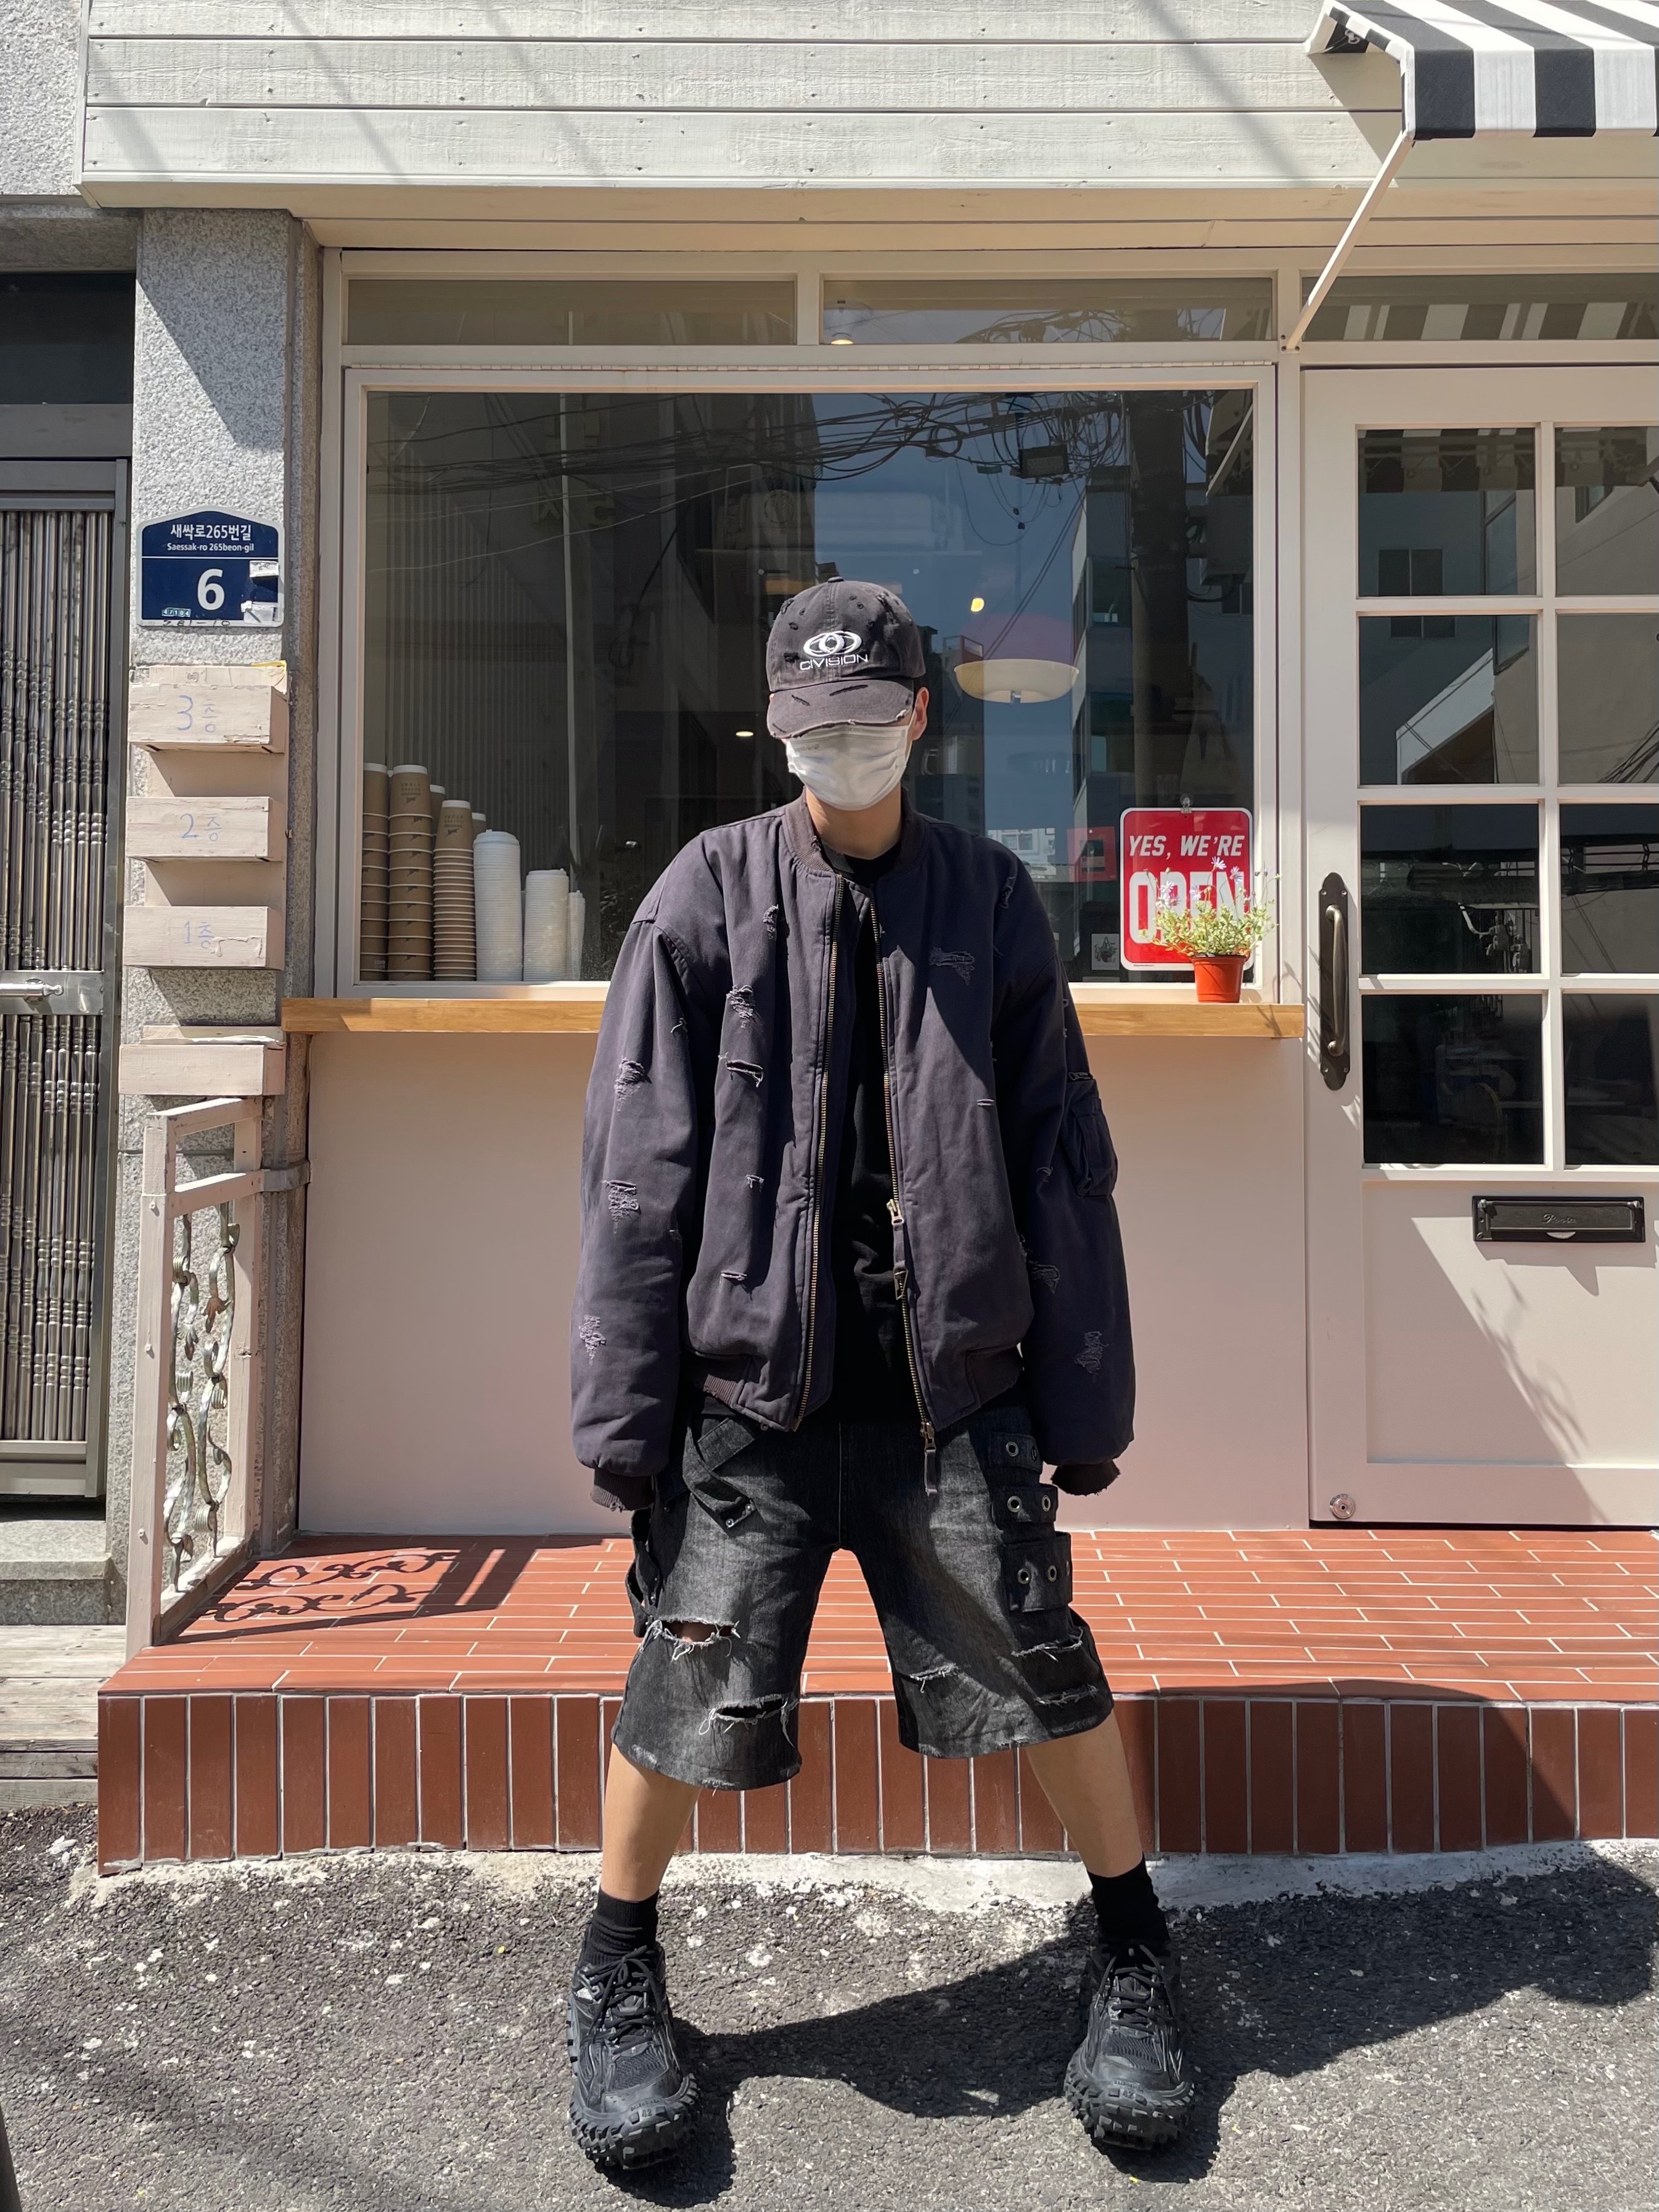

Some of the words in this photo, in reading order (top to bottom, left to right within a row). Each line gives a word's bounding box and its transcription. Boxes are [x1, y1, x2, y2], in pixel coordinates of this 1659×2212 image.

[170, 524, 252, 541] 새싹로265번길
[167, 543, 208, 551] Saessak-ro
[209, 543, 255, 553] 265beon-gil
[197, 568, 225, 610] 6
[163, 608, 190, 617] 47104
[800, 653, 868, 671] CIVISION
[177, 694, 218, 733] 3층
[180, 813, 223, 842] 2층
[1129, 835, 1171, 860] YES,
[1180, 835, 1245, 857] WE'RE
[1129, 871, 1245, 944] OPEN
[184, 920, 215, 949] 1층
[641, 2108, 652, 2118] 42
